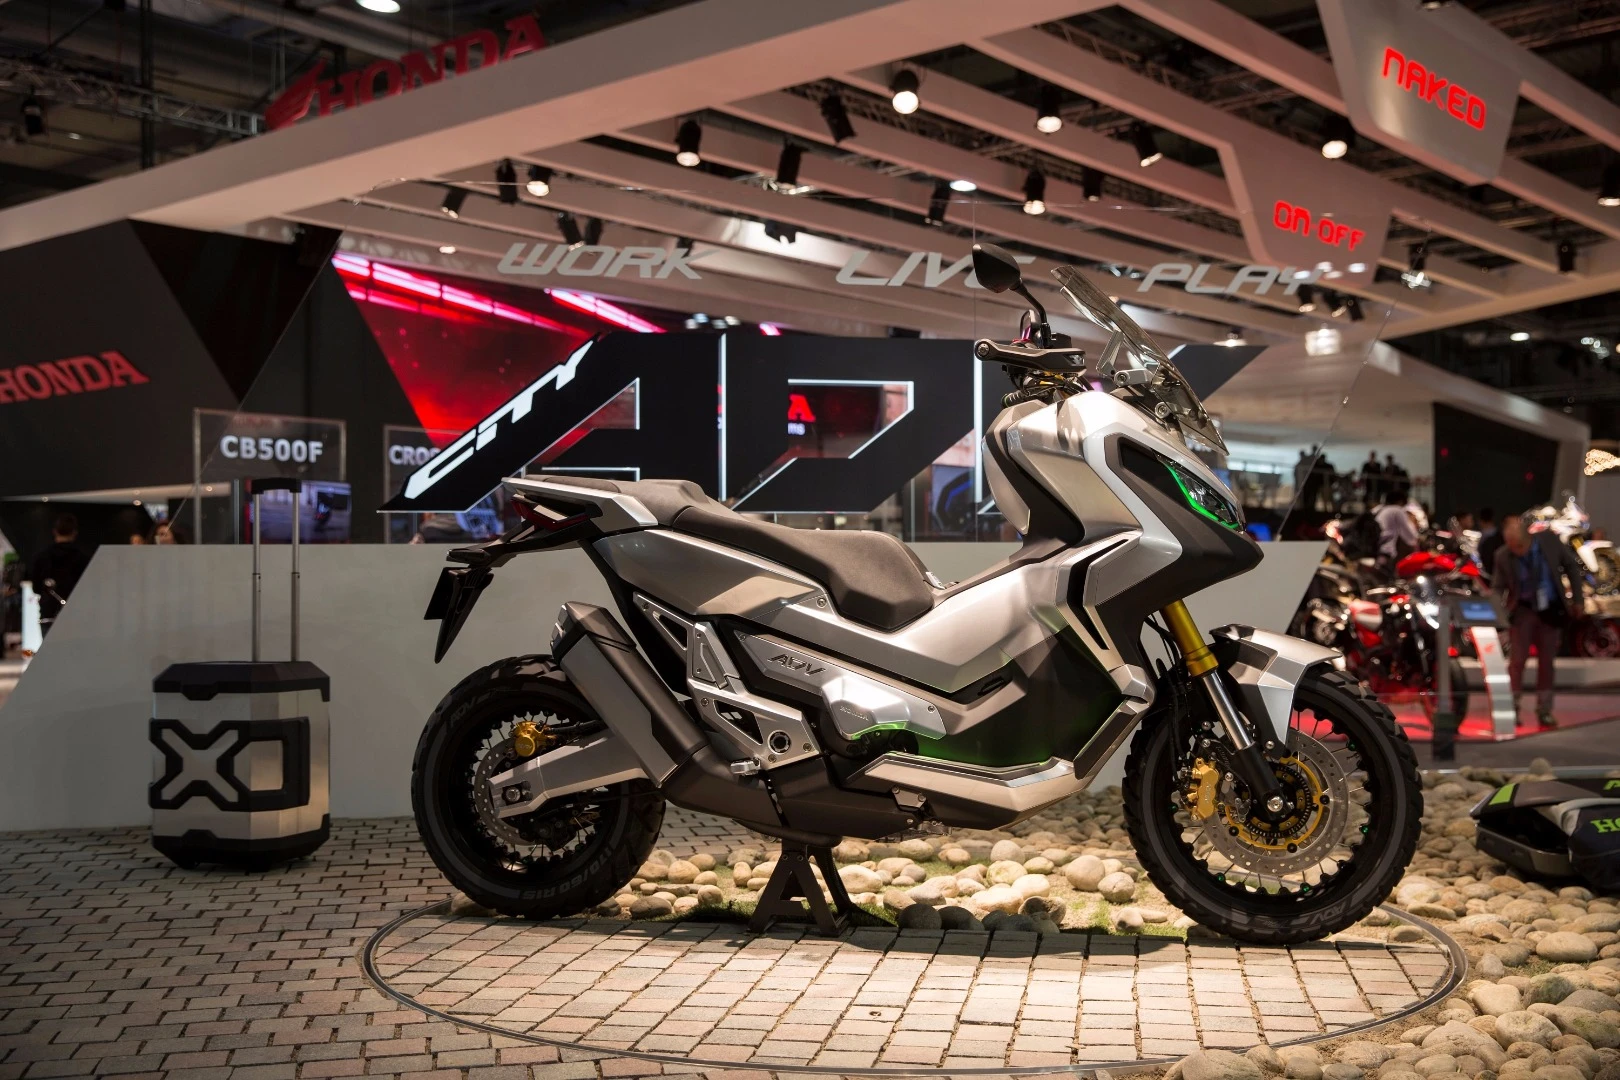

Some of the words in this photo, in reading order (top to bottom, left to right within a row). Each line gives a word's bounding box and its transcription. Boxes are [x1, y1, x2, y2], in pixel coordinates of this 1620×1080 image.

[313, 15, 546, 117] HONDA
[1383, 46, 1486, 130] NAKED
[497, 242, 720, 279] WORK
[1136, 263, 1325, 296] PLAY
[220, 435, 324, 464] CB500F
[404, 340, 593, 500] CITY
[767, 654, 827, 677] ADV
